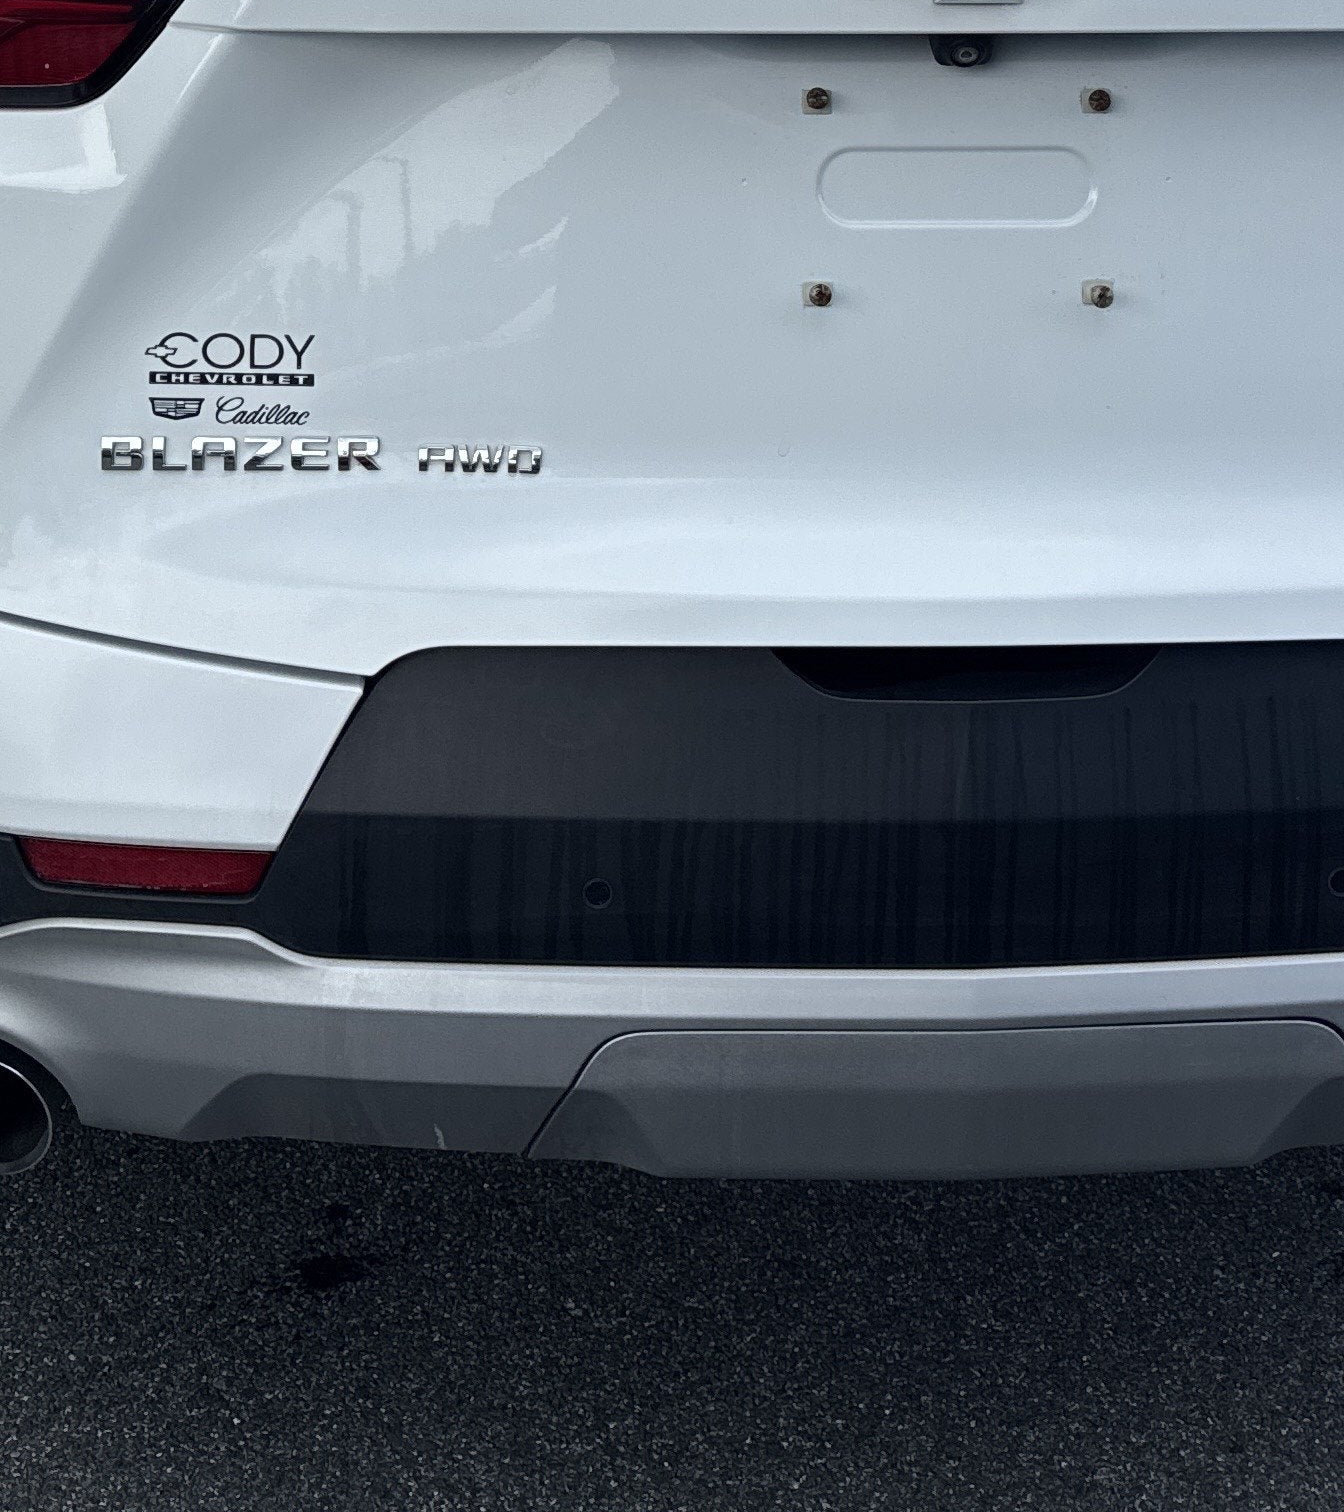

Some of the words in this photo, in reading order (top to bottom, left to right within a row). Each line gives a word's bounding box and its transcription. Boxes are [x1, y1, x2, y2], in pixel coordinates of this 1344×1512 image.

[155, 331, 316, 370] CODY
[155, 372, 309, 386] CHEVROLET
[215, 395, 311, 426] Cadillac
[100, 434, 382, 472] BLAZER
[417, 443, 544, 476] AWD
